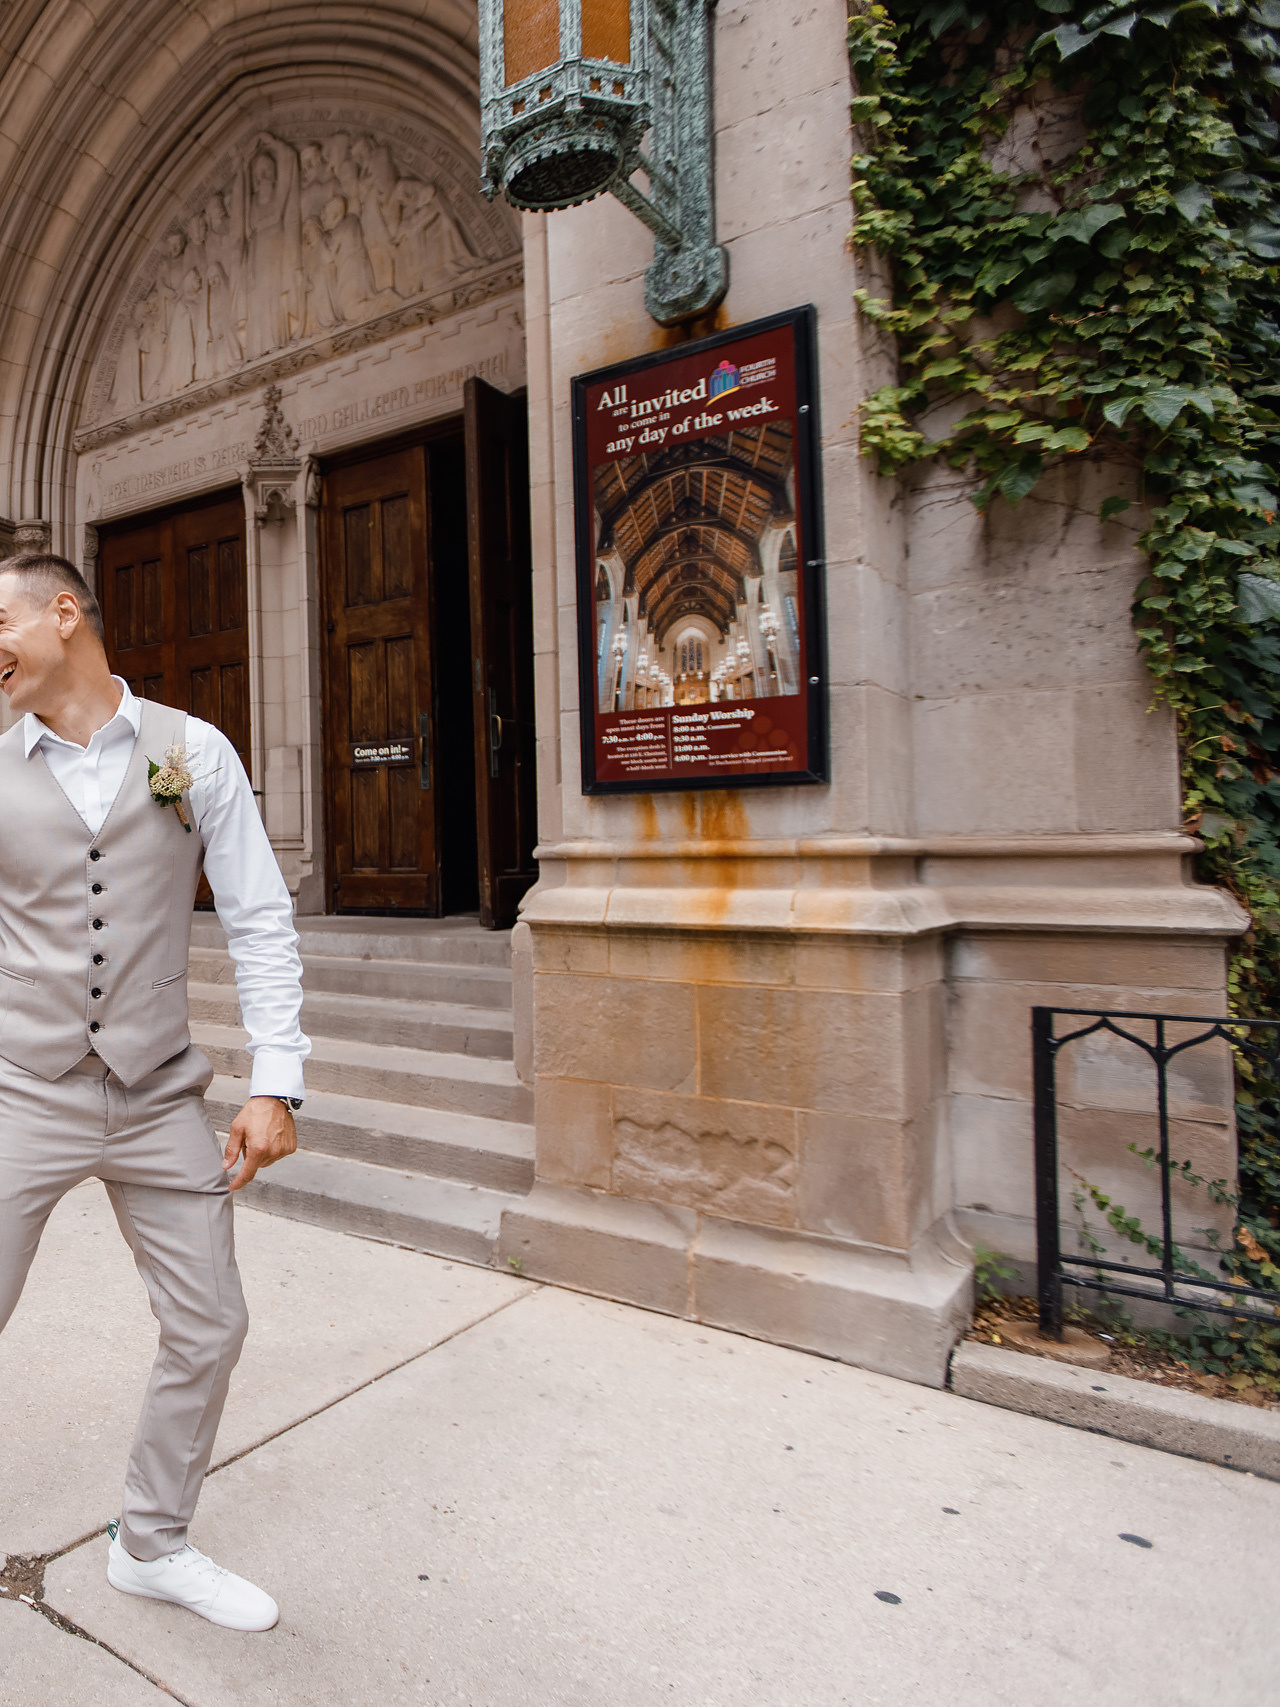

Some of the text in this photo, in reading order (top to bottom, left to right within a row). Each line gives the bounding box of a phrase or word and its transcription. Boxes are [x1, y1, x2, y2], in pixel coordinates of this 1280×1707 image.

[739, 357, 776, 373] FOURTH
[739, 369, 777, 385] CHURCH
[596, 384, 628, 411] All
[612, 406, 629, 417] are
[630, 378, 708, 418] invited
[606, 396, 779, 453] any day of the week.
[618, 411, 671, 433] to come in
[672, 708, 755, 723] Sunday Worship
[673, 725, 689, 733] 8:00
[707, 722, 741, 730] Communion
[601, 735, 618, 744] 7:30
[635, 732, 654, 741] 4:00
[354, 744, 401, 757] Come on in!
[673, 744, 693, 752] 11:00
[673, 754, 690, 762] 4:00
[690, 754, 708, 763] p.m.
